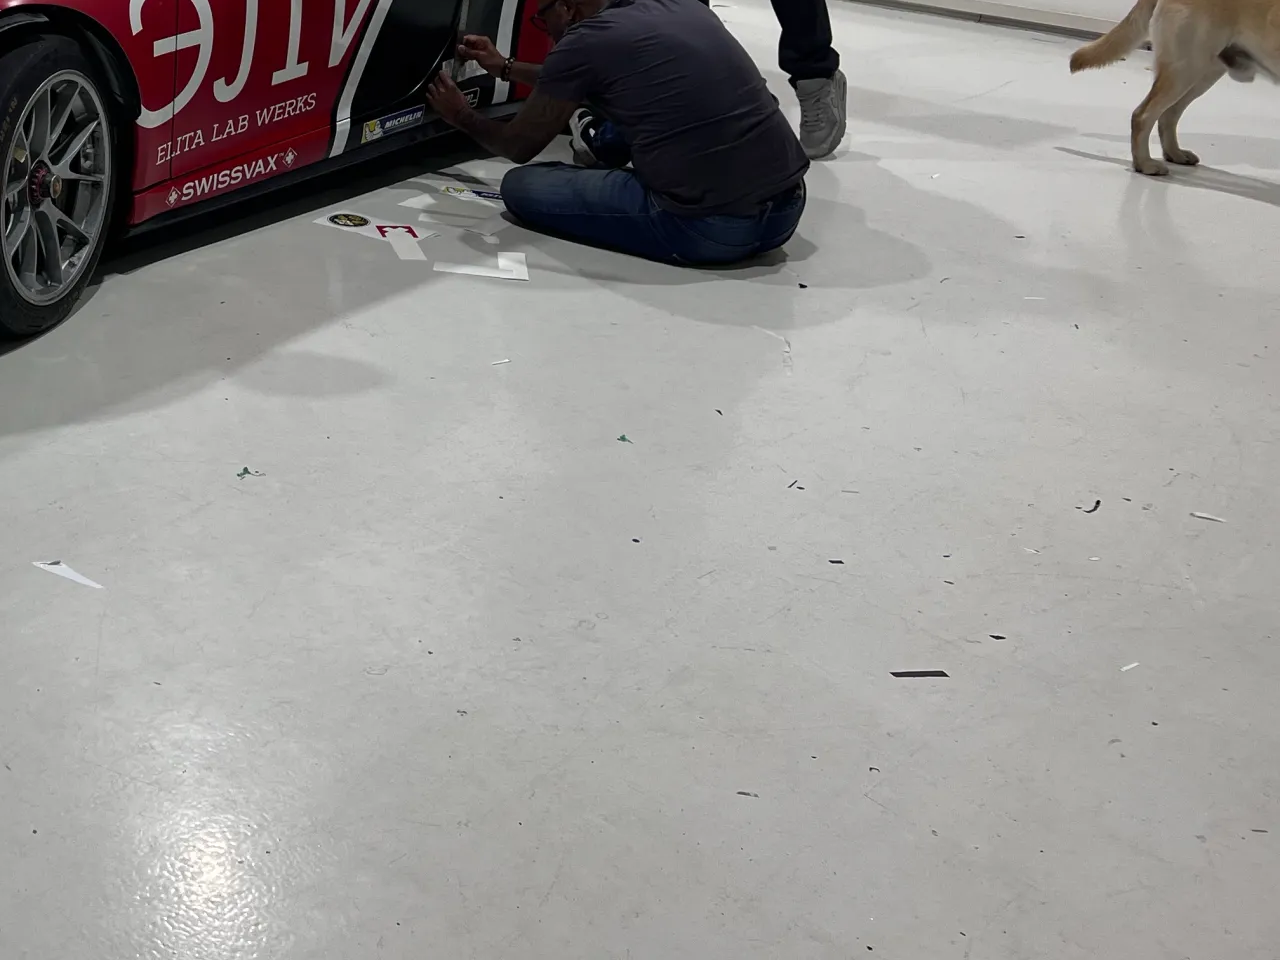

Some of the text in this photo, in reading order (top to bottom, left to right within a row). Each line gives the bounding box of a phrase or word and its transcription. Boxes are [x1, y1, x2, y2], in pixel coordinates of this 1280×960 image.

[156, 93, 317, 165] ELITA LAB WERKS
[384, 110, 422, 129] MICHELIN
